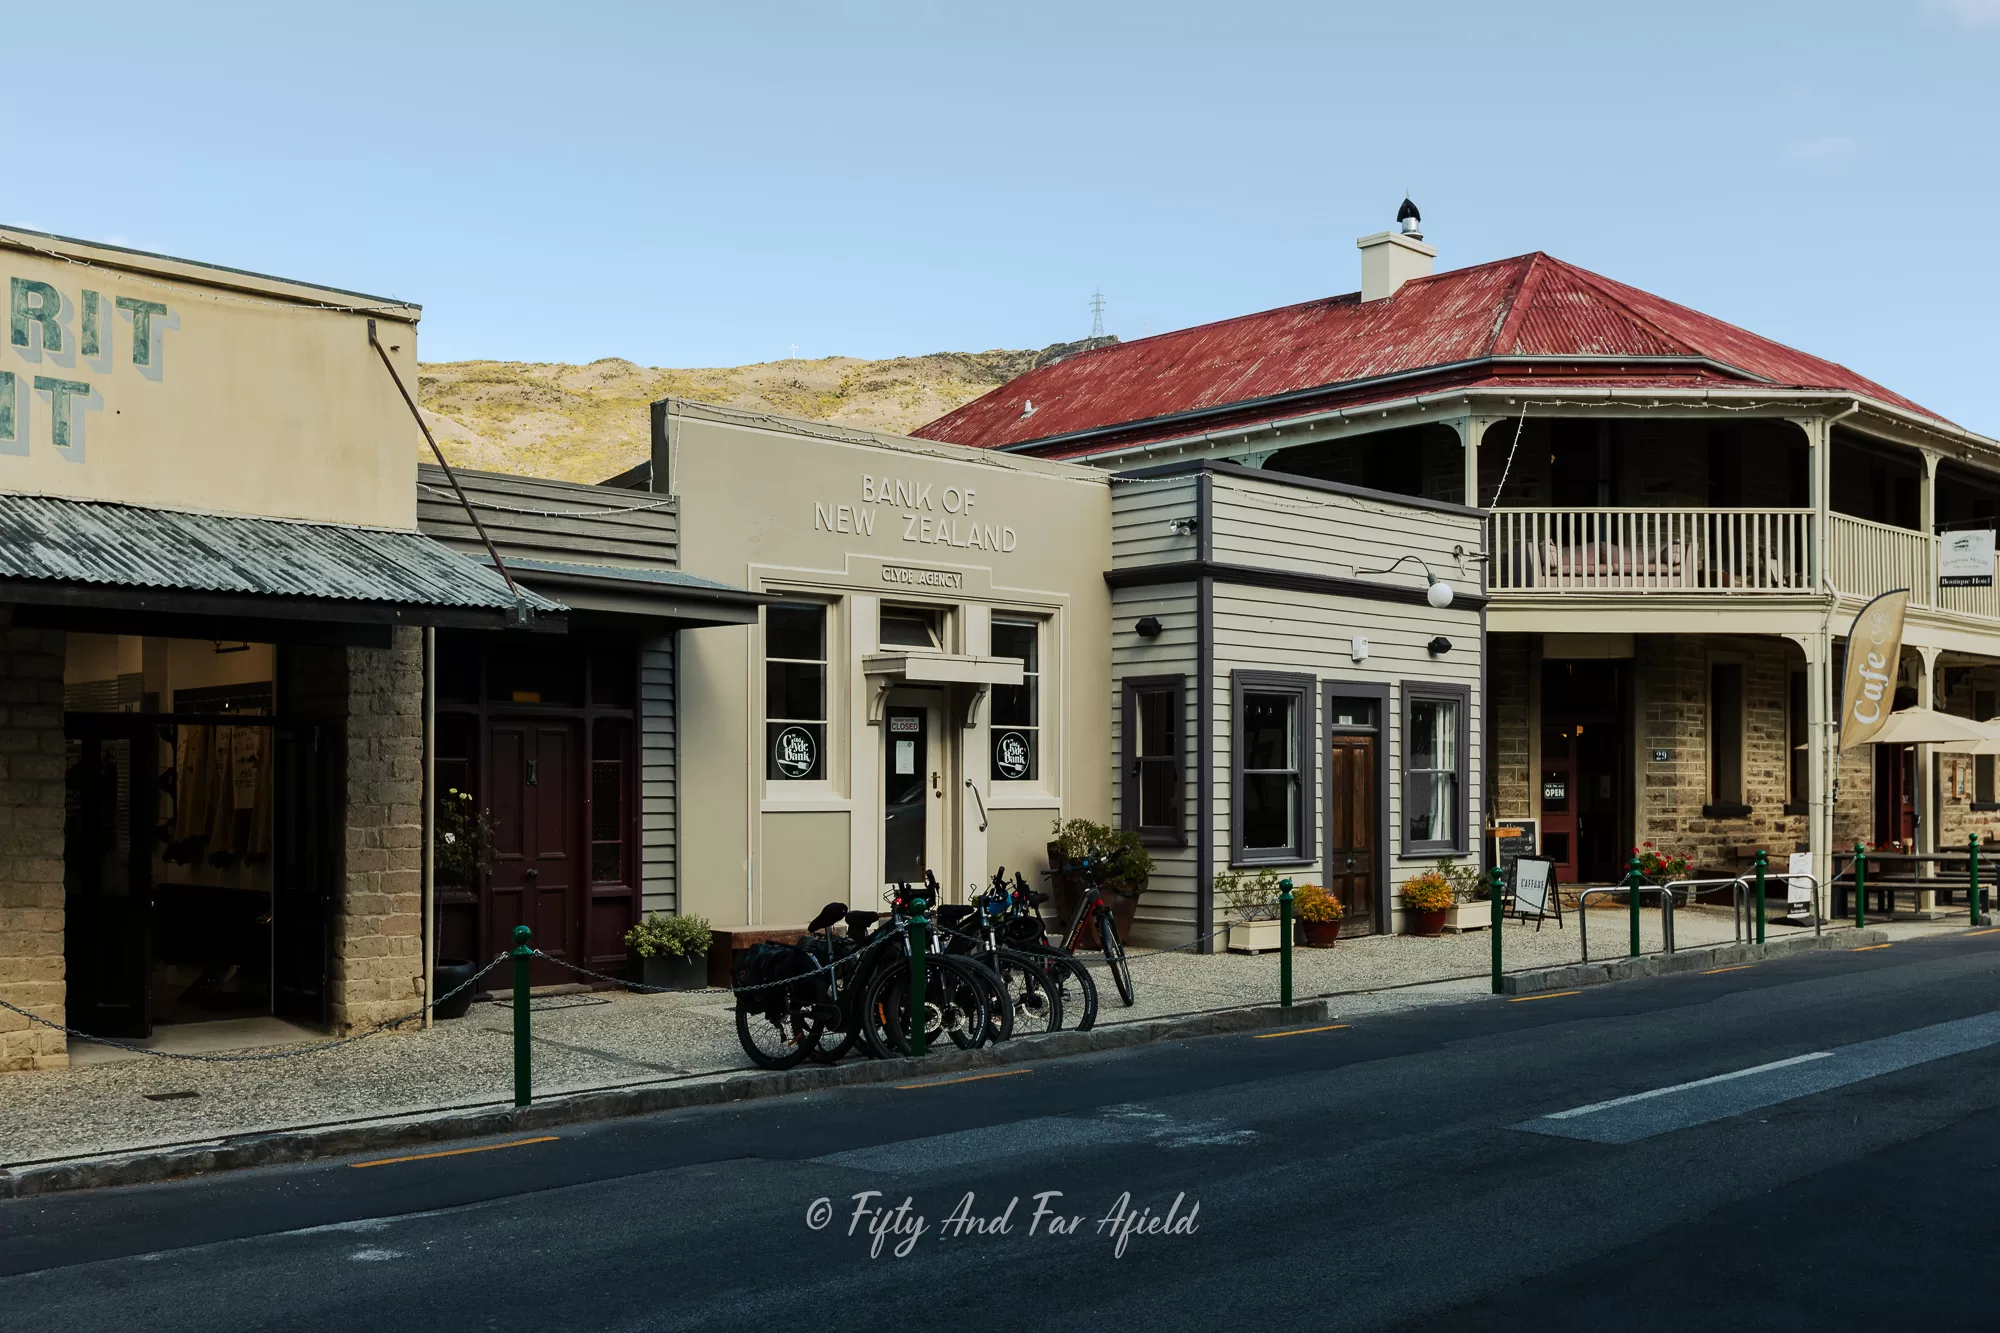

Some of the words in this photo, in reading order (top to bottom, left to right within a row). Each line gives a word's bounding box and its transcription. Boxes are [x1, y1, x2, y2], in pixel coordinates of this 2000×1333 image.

[862, 474, 933, 511] BANK
[941, 486, 976, 516] OF
[814, 501, 876, 536] NEW
[902, 514, 1017, 553] ZEALAND
[882, 567, 913, 585] CLYDE
[917, 571, 962, 589] AGENCY
[1941, 578, 1970, 586] Boutique
[1972, 577, 1990, 585] Hotel
[1854, 652, 1889, 725] Cafe
[891, 722, 919, 731] CLOSED
[782, 734, 809, 752] Clyde
[1002, 739, 1024, 755] Clyde
[784, 747, 811, 762] Bank
[1004, 750, 1026, 765] Bank
[1656, 751, 1667, 760] 29
[1545, 788, 1564, 797] OPEN
